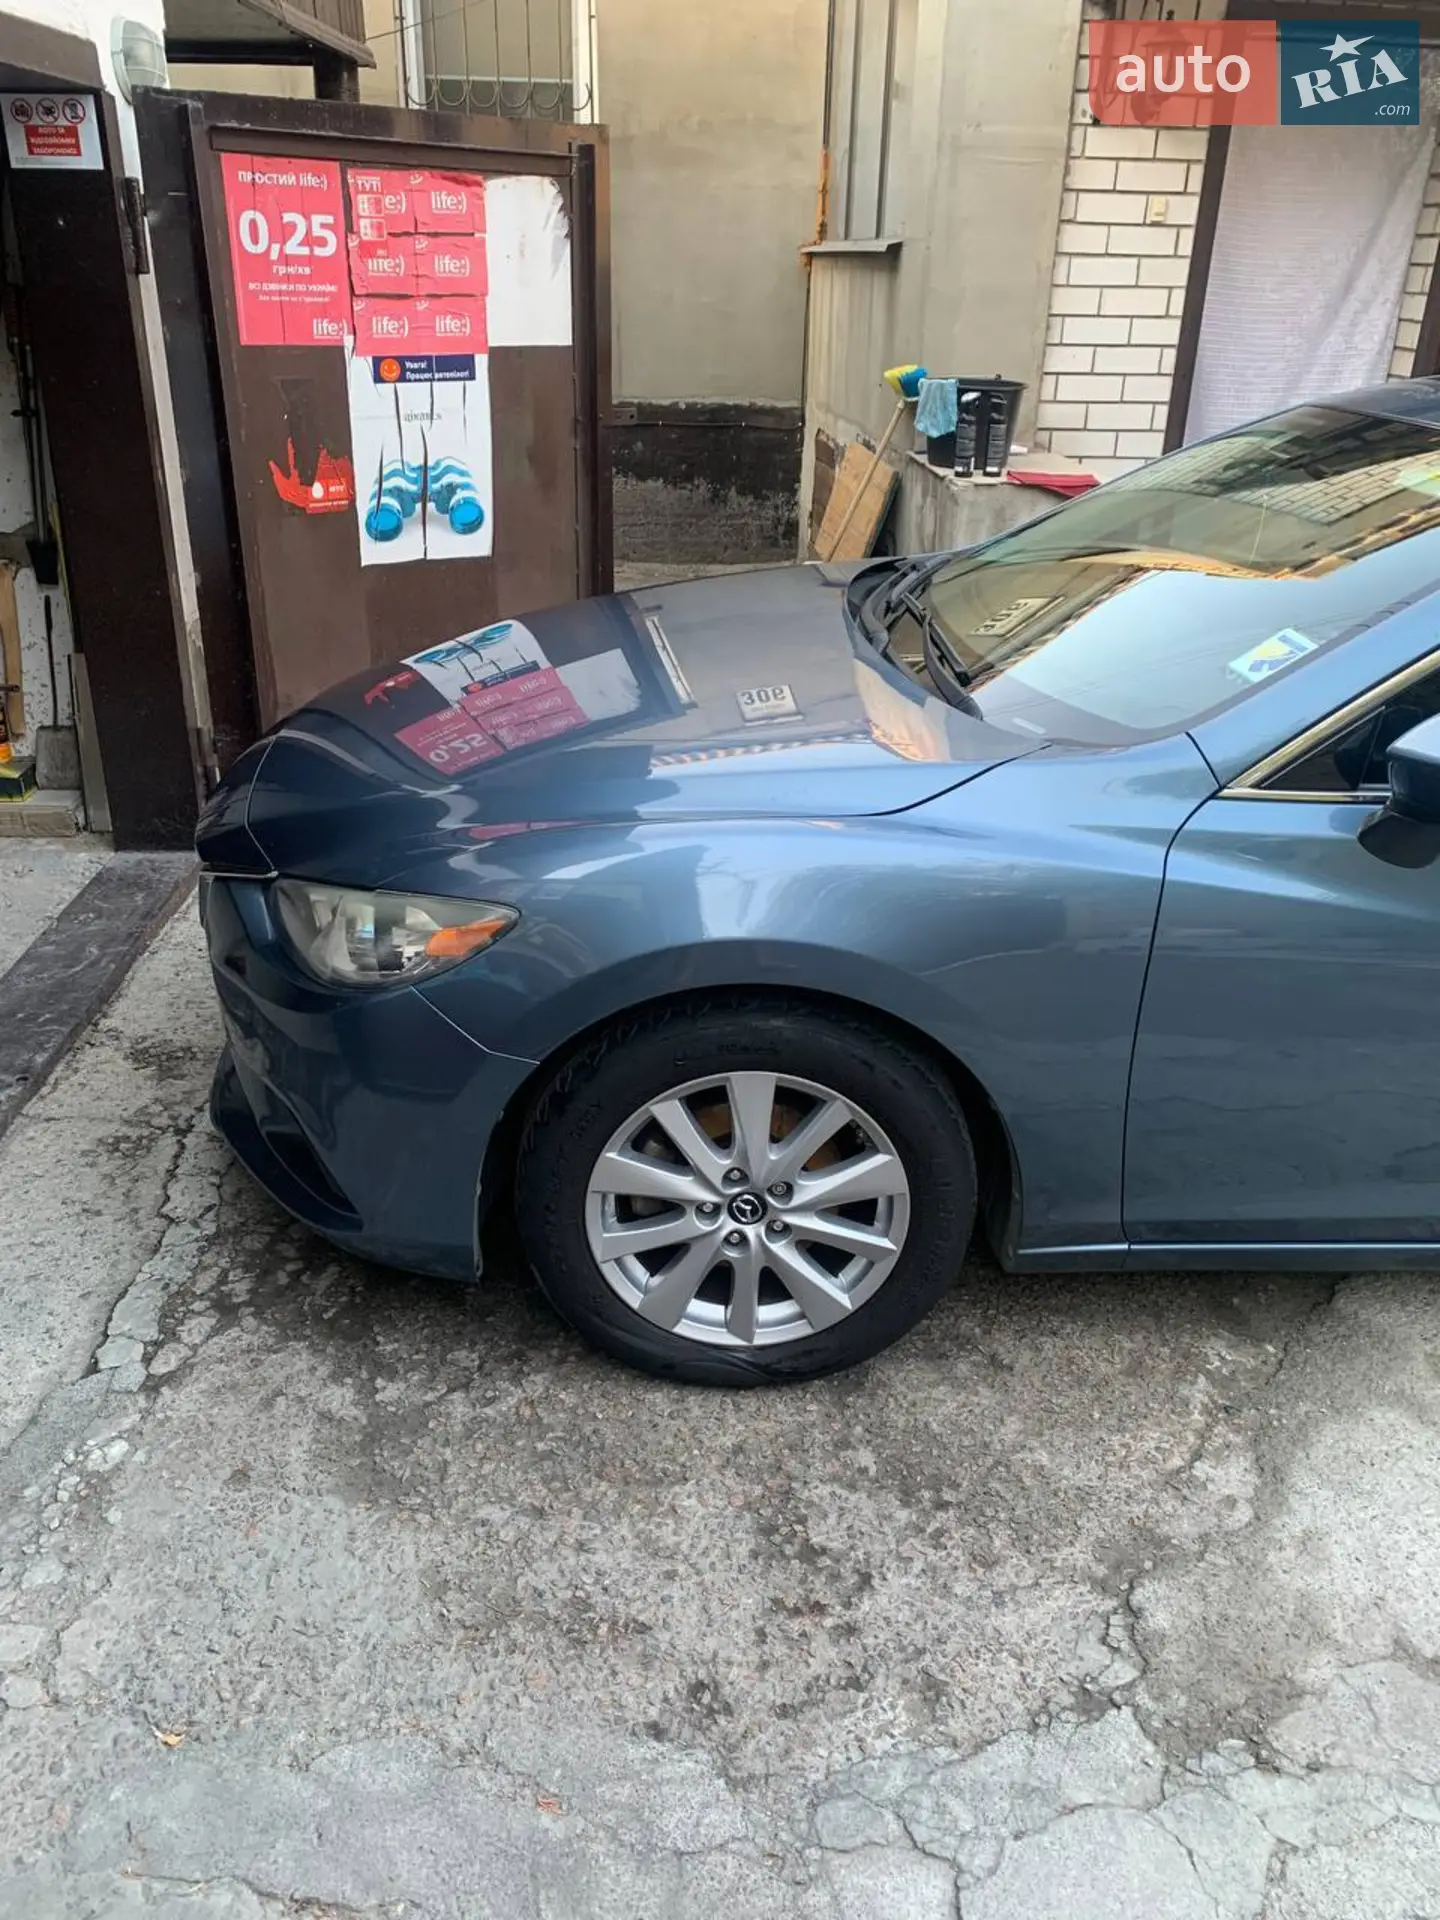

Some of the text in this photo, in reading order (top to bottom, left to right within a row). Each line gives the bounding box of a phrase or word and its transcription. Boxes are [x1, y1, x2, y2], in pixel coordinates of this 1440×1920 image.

[238, 171, 327, 191] ПРОСТИЙ life:)
[431, 191, 467, 214] life:)
[239, 210, 338, 261] 0,25
[434, 253, 470, 277] life:)
[312, 317, 348, 340] life:)
[372, 315, 409, 338] life:)
[435, 315, 471, 336] life:)
